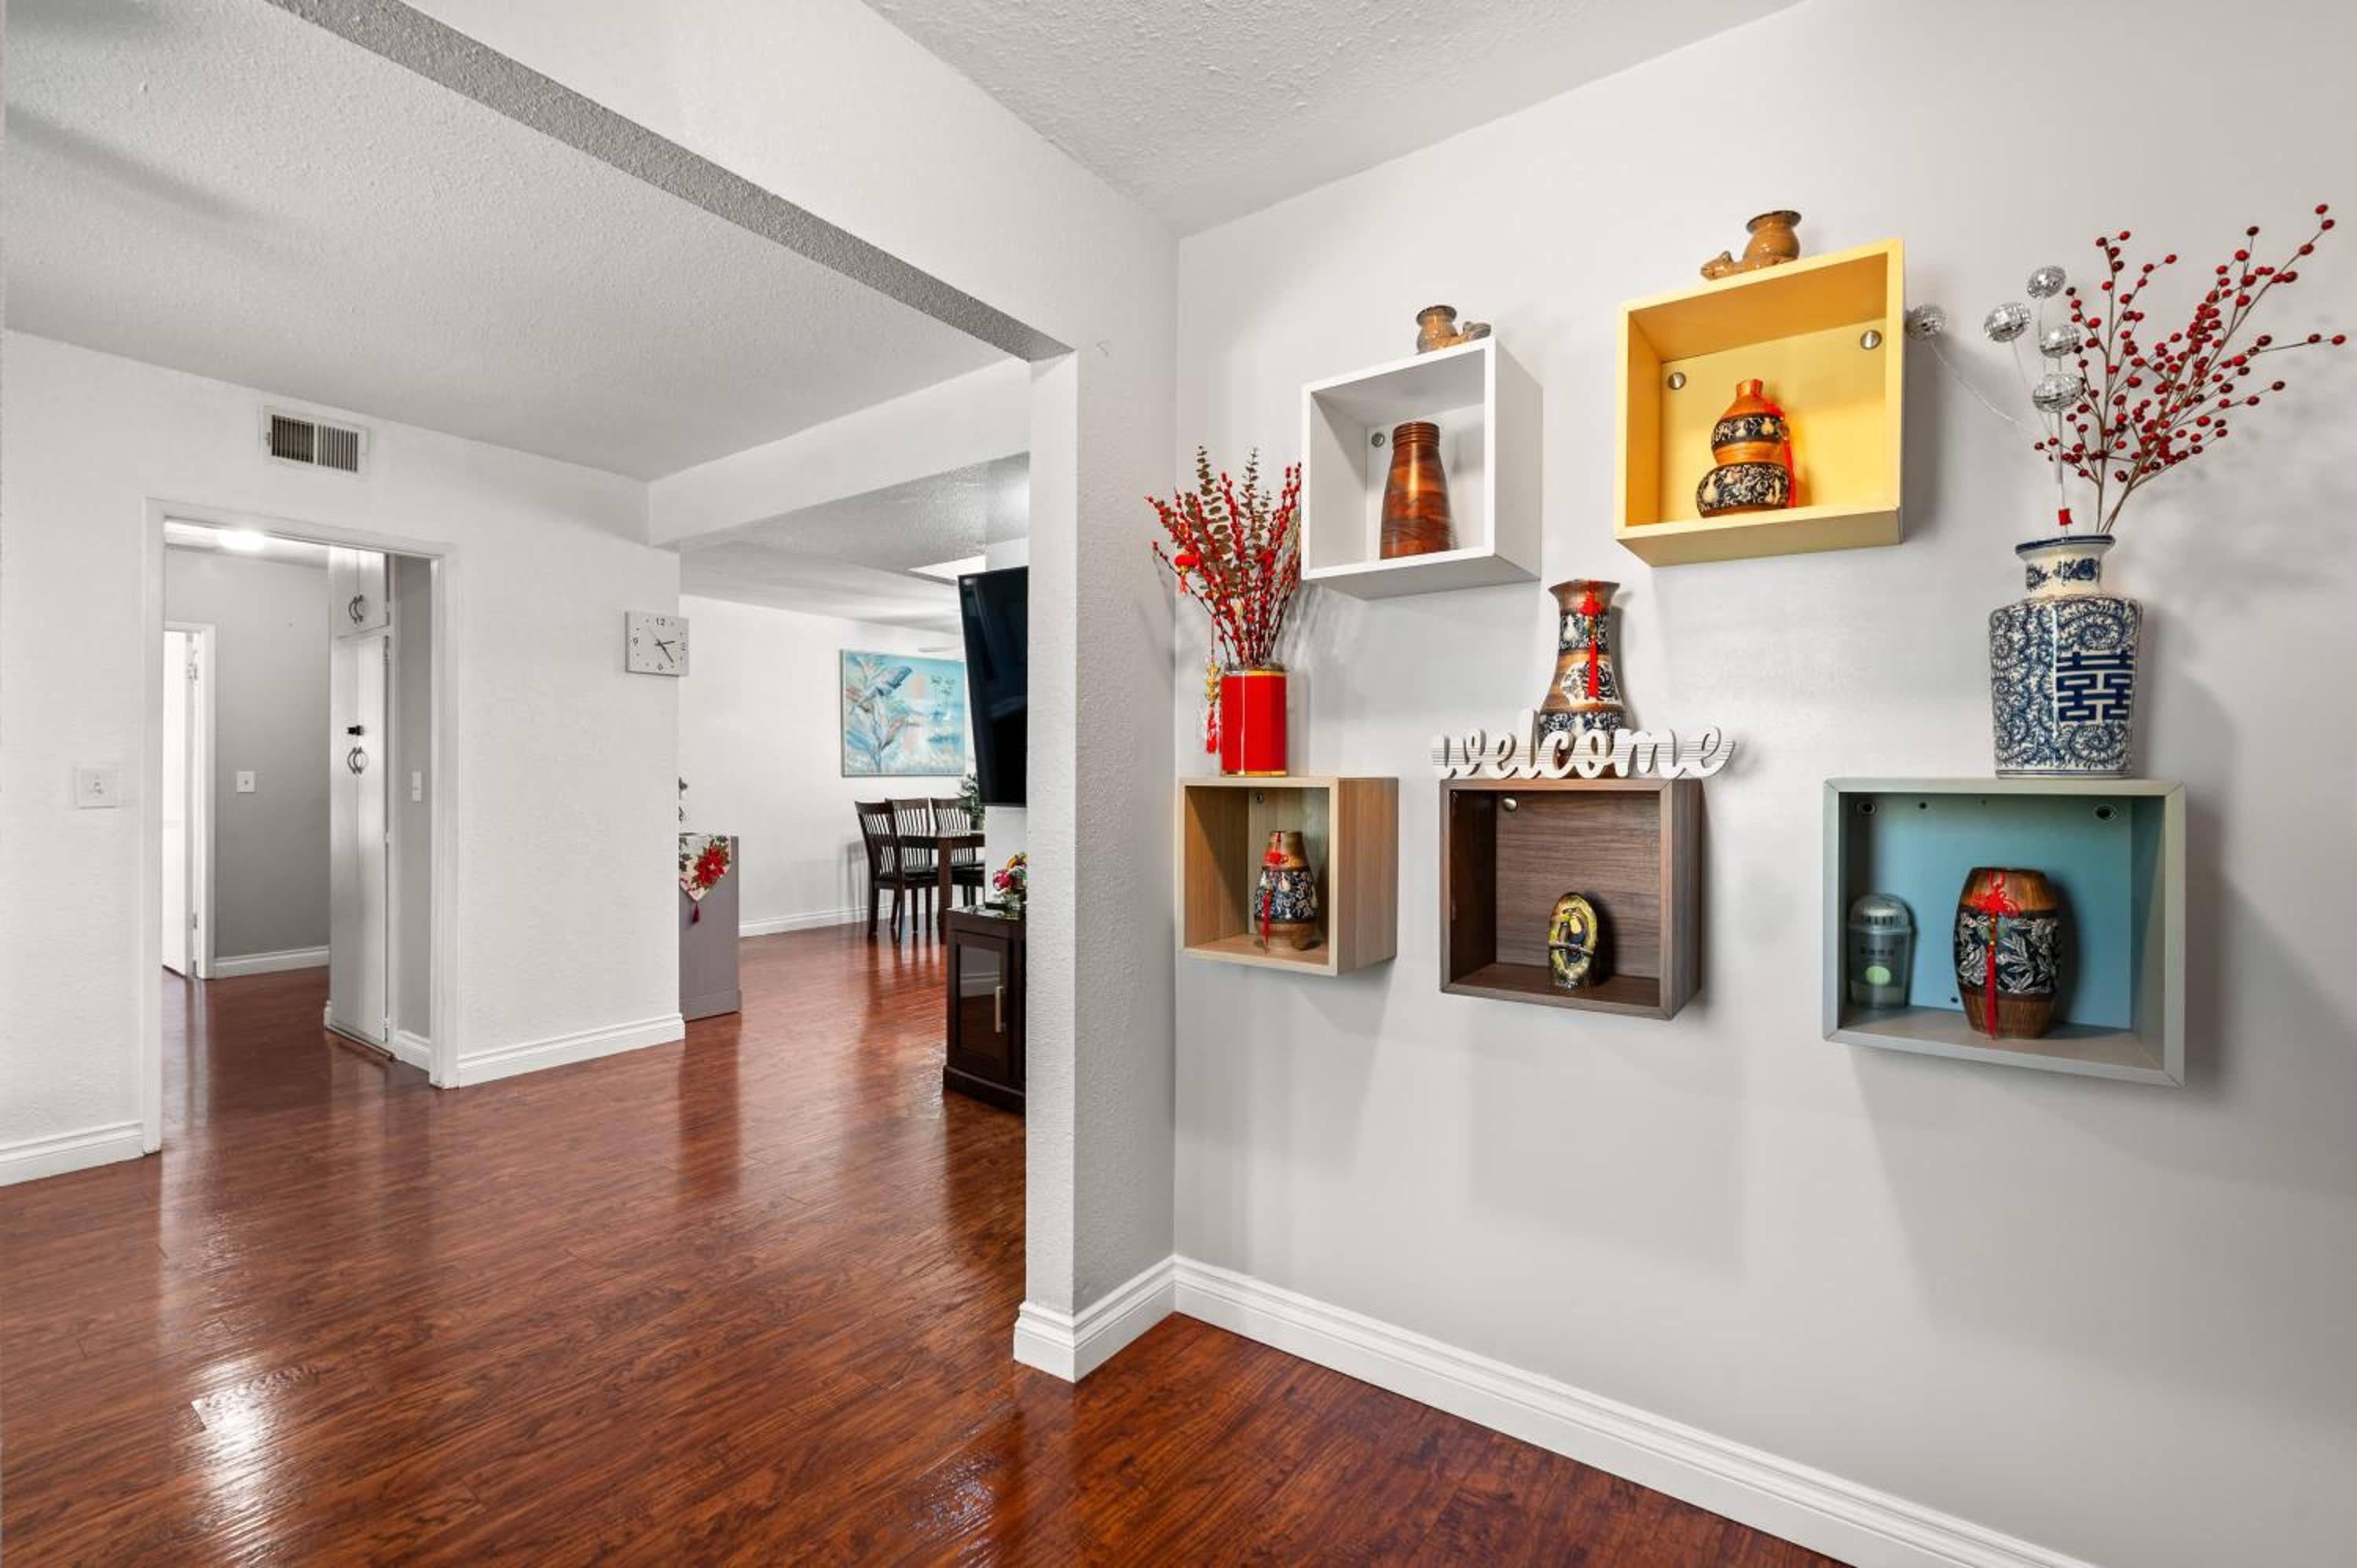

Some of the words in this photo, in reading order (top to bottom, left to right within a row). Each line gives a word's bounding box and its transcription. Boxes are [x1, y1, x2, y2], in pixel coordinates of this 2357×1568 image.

[655, 617, 665, 626] 12
[632, 637, 639, 646] 9
[1431, 709, 1735, 779] welcome
